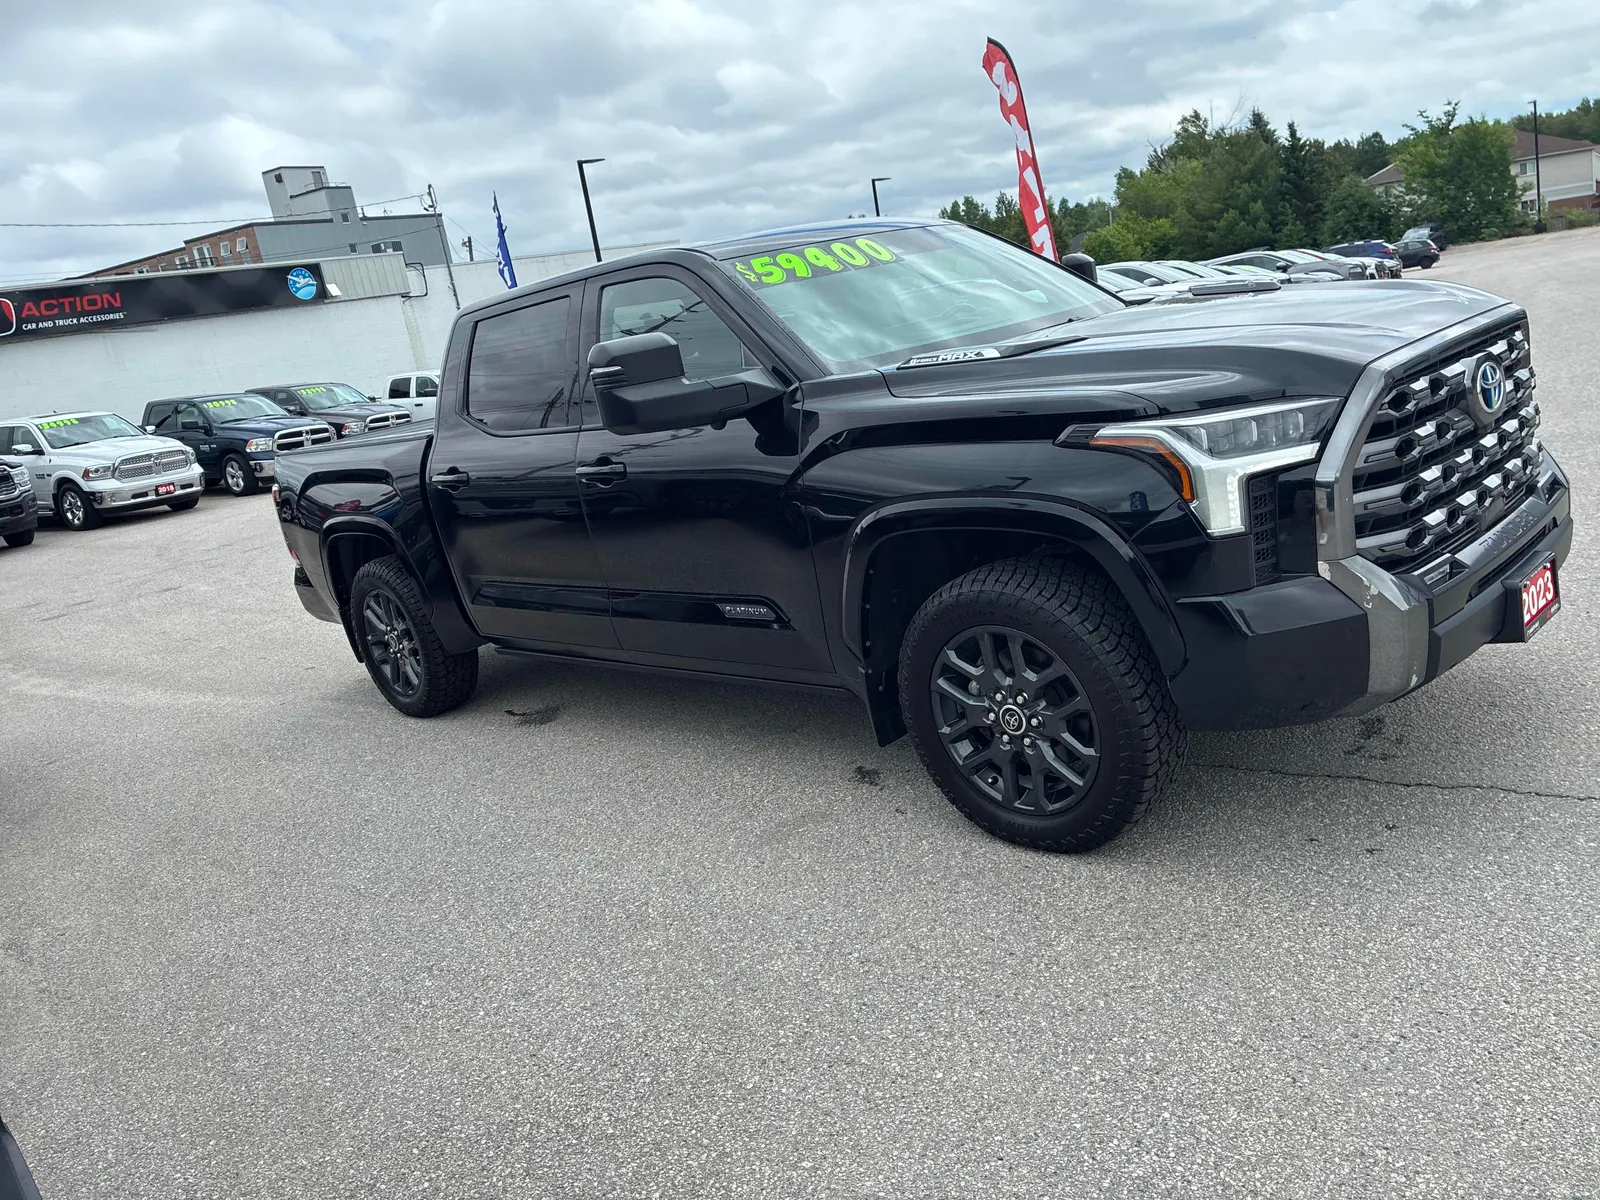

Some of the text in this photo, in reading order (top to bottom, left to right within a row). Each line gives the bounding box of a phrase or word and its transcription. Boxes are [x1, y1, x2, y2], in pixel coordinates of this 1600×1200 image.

[735, 238, 896, 284] $59400
[21, 292, 121, 318] ACTION
[22, 323, 37, 331] CAR
[38, 321, 54, 329] AND
[55, 317, 78, 326] TRUCK
[939, 351, 979, 361] MAX
[1522, 570, 1553, 623] 2023
[726, 606, 767, 615] PLATINUM
